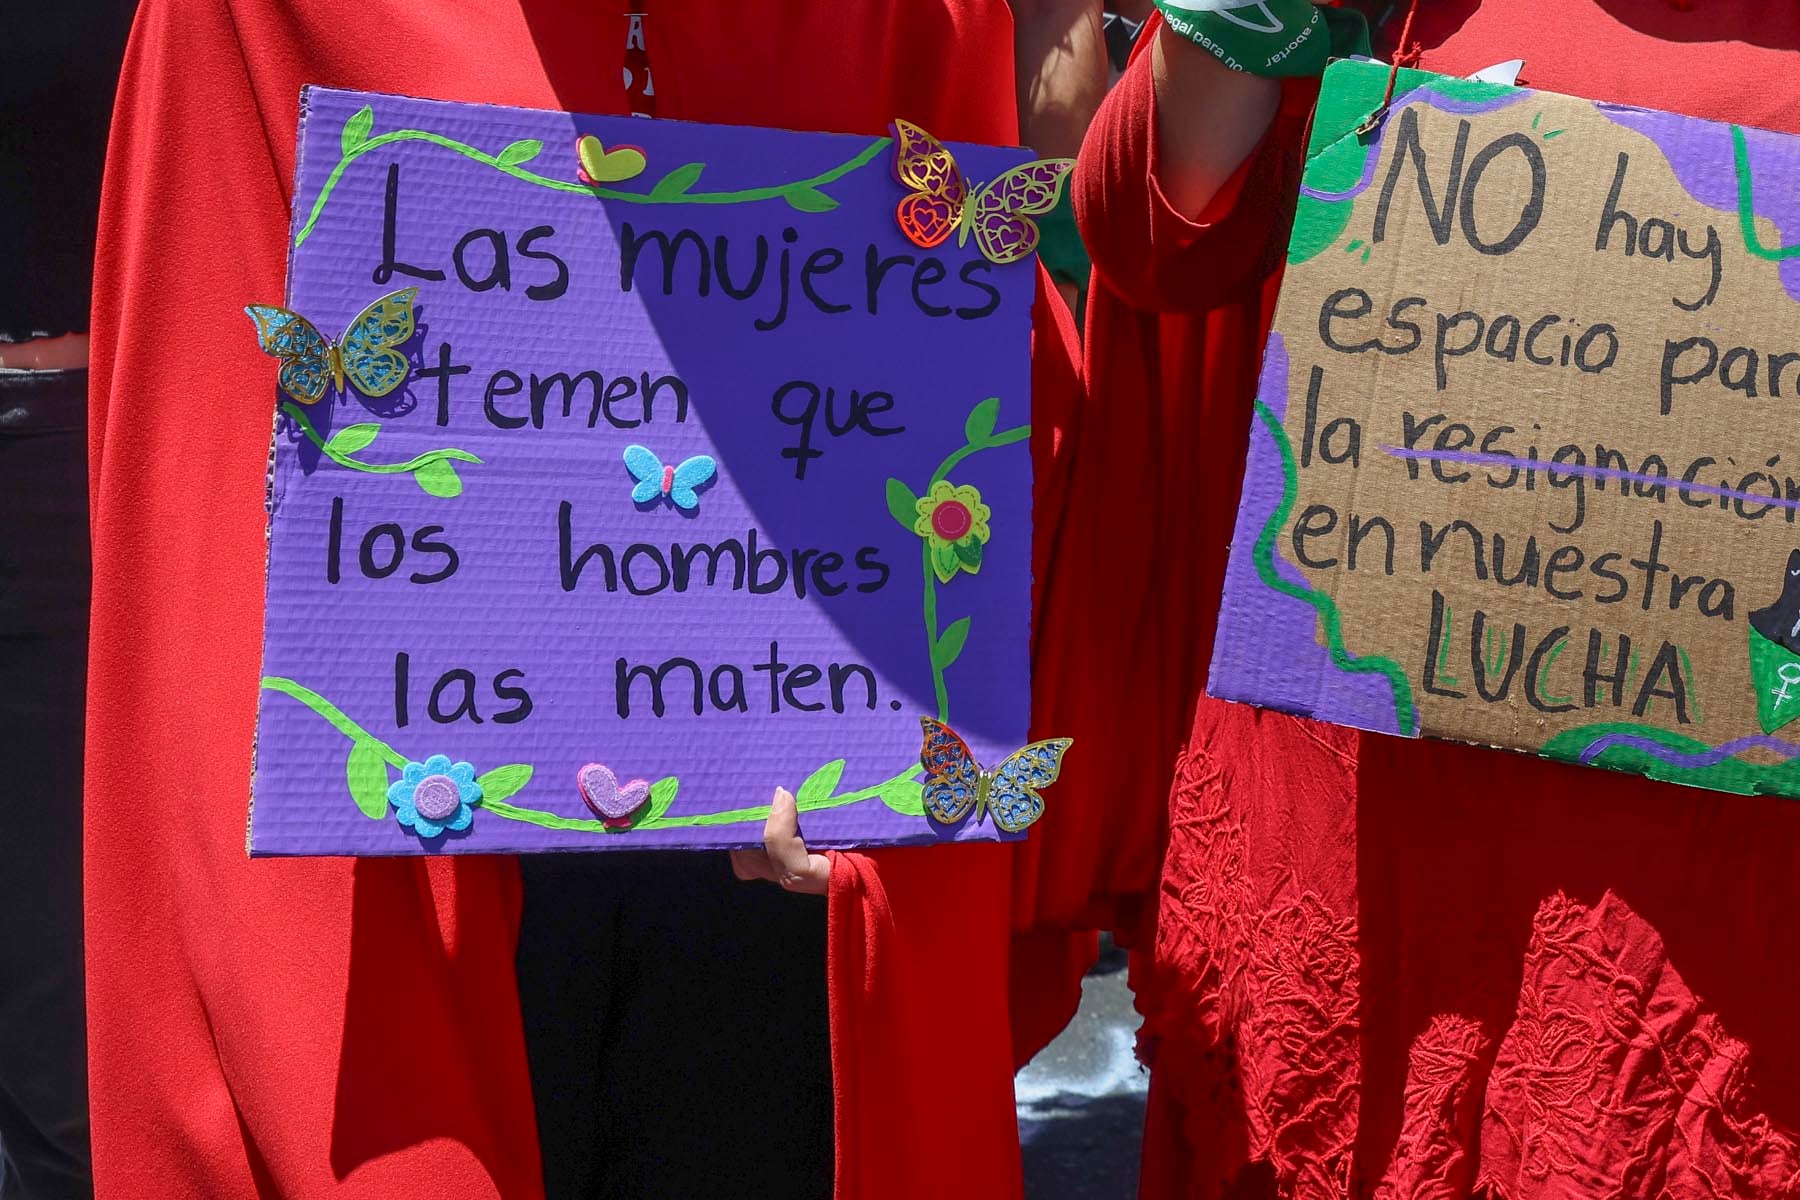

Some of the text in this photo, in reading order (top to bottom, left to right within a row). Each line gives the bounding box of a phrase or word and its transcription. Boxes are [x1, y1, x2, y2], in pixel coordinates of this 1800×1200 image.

[1164, 9, 1193, 35] legal
[1193, 32, 1224, 59] para
[1265, 27, 1312, 68] abortar
[372, 163, 1003, 332] Las mujeres
[1372, 107, 1723, 311] NO hay
[1317, 285, 1619, 390] espacio
[417, 343, 906, 480] temen que
[1300, 365, 1362, 469] la
[326, 496, 891, 598] los hombres
[1292, 503, 1737, 620] en nuestra
[394, 641, 904, 729] las maten.
[1422, 590, 1693, 725] LUCHA
